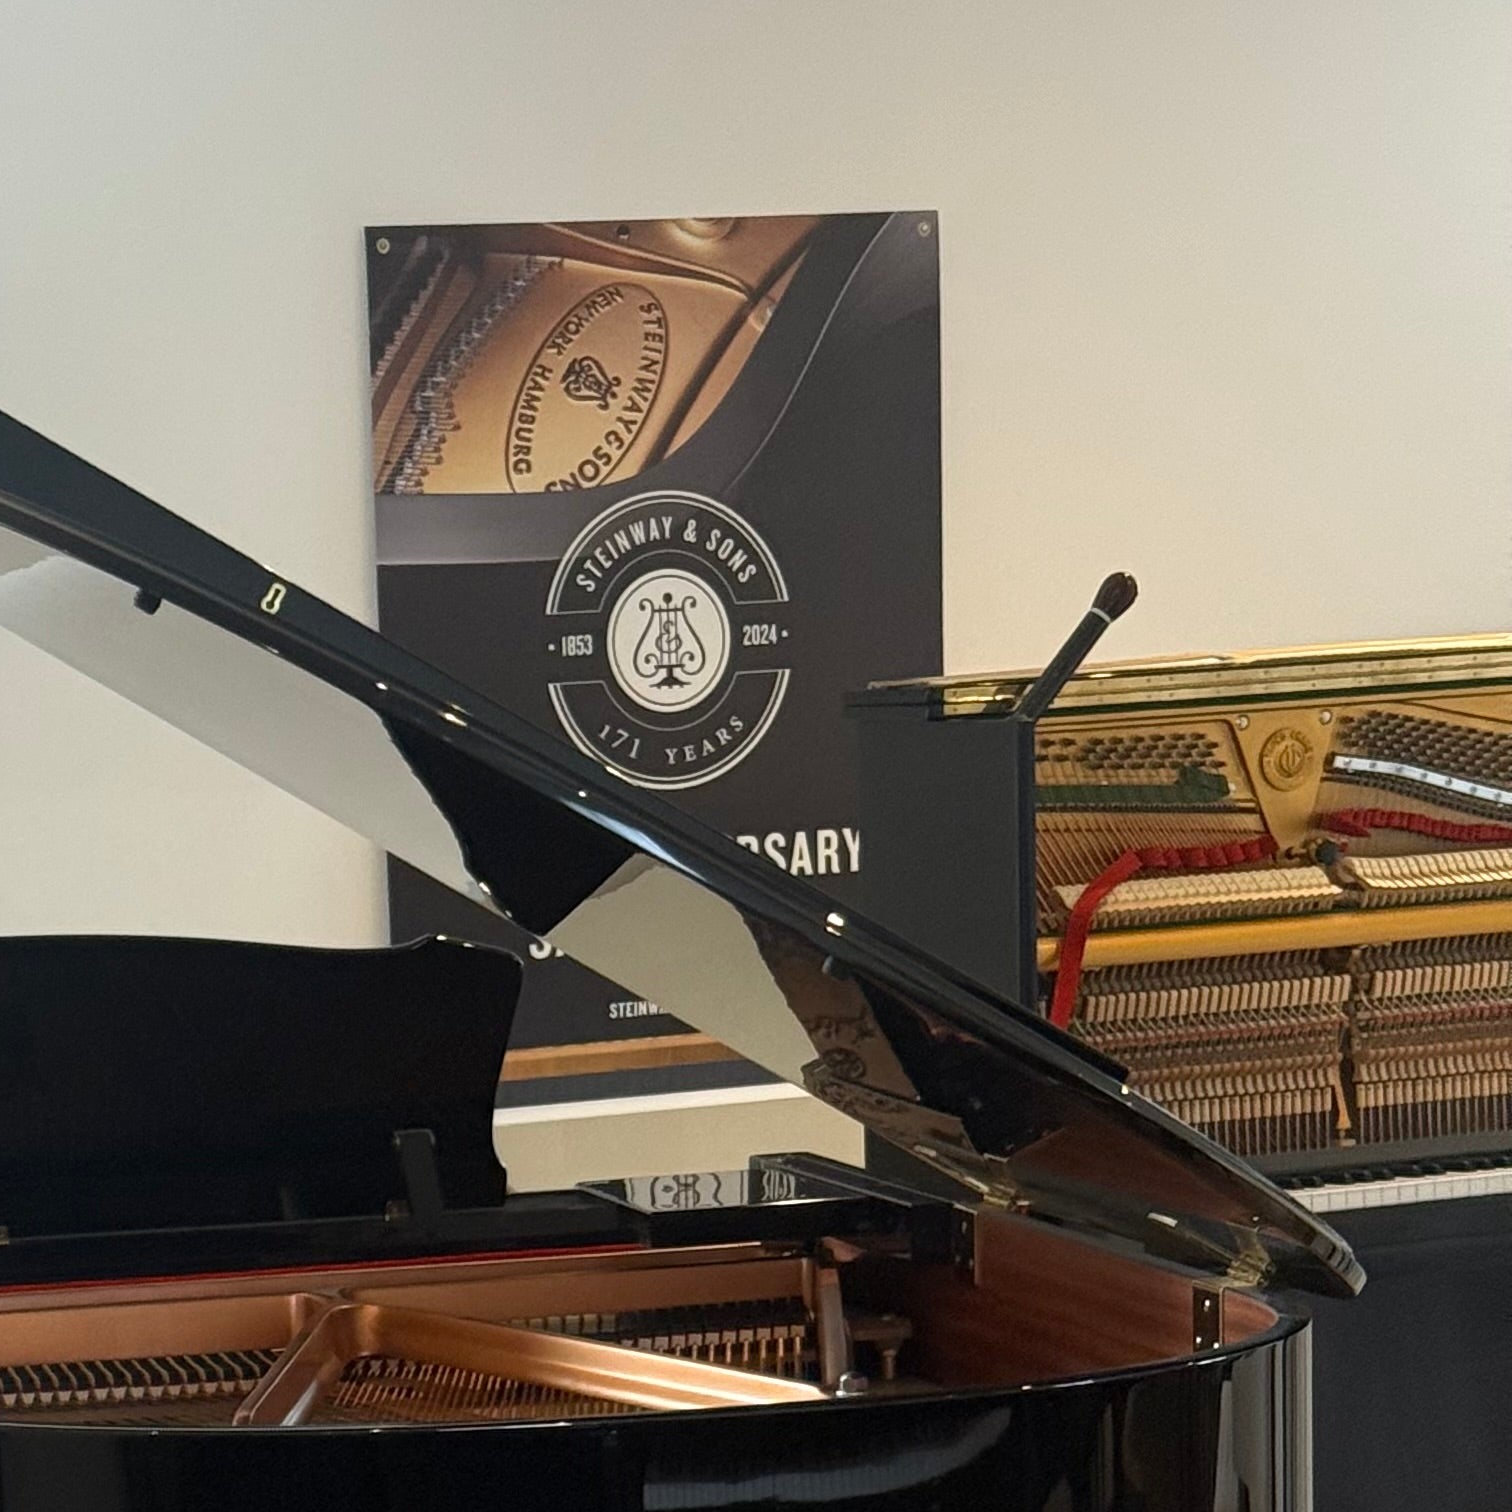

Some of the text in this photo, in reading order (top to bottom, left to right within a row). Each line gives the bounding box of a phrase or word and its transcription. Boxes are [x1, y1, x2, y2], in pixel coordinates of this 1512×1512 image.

[513, 287, 624, 475] NEW YORK HAMBURG
[576, 516, 757, 592] STEINWAY & SONS
[561, 634, 593, 657] 1853
[743, 624, 778, 646] 2024
[598, 715, 744, 765] 171 YEARS
